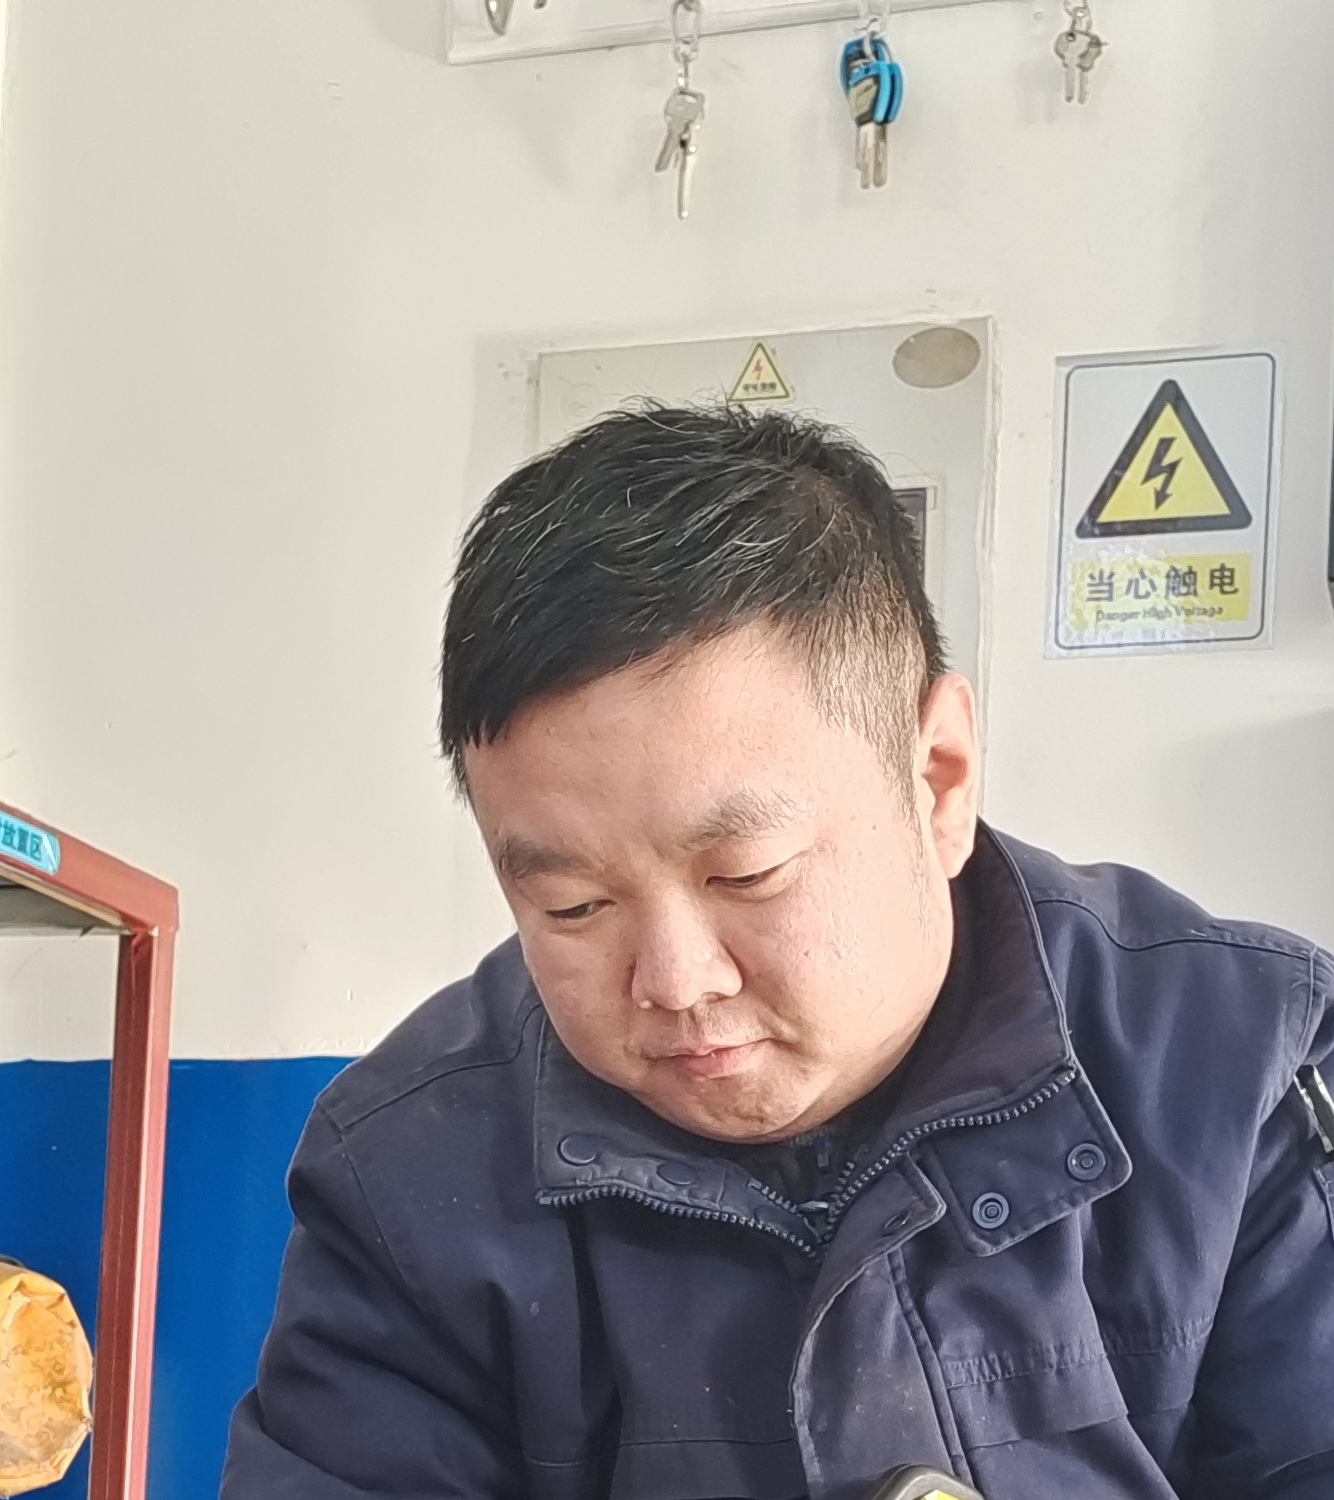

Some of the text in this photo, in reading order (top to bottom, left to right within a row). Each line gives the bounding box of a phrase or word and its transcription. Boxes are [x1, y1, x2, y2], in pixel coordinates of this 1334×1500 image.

[1086, 562, 1240, 602] 当心触电
[1096, 603, 1224, 622] Danger High Voltage
